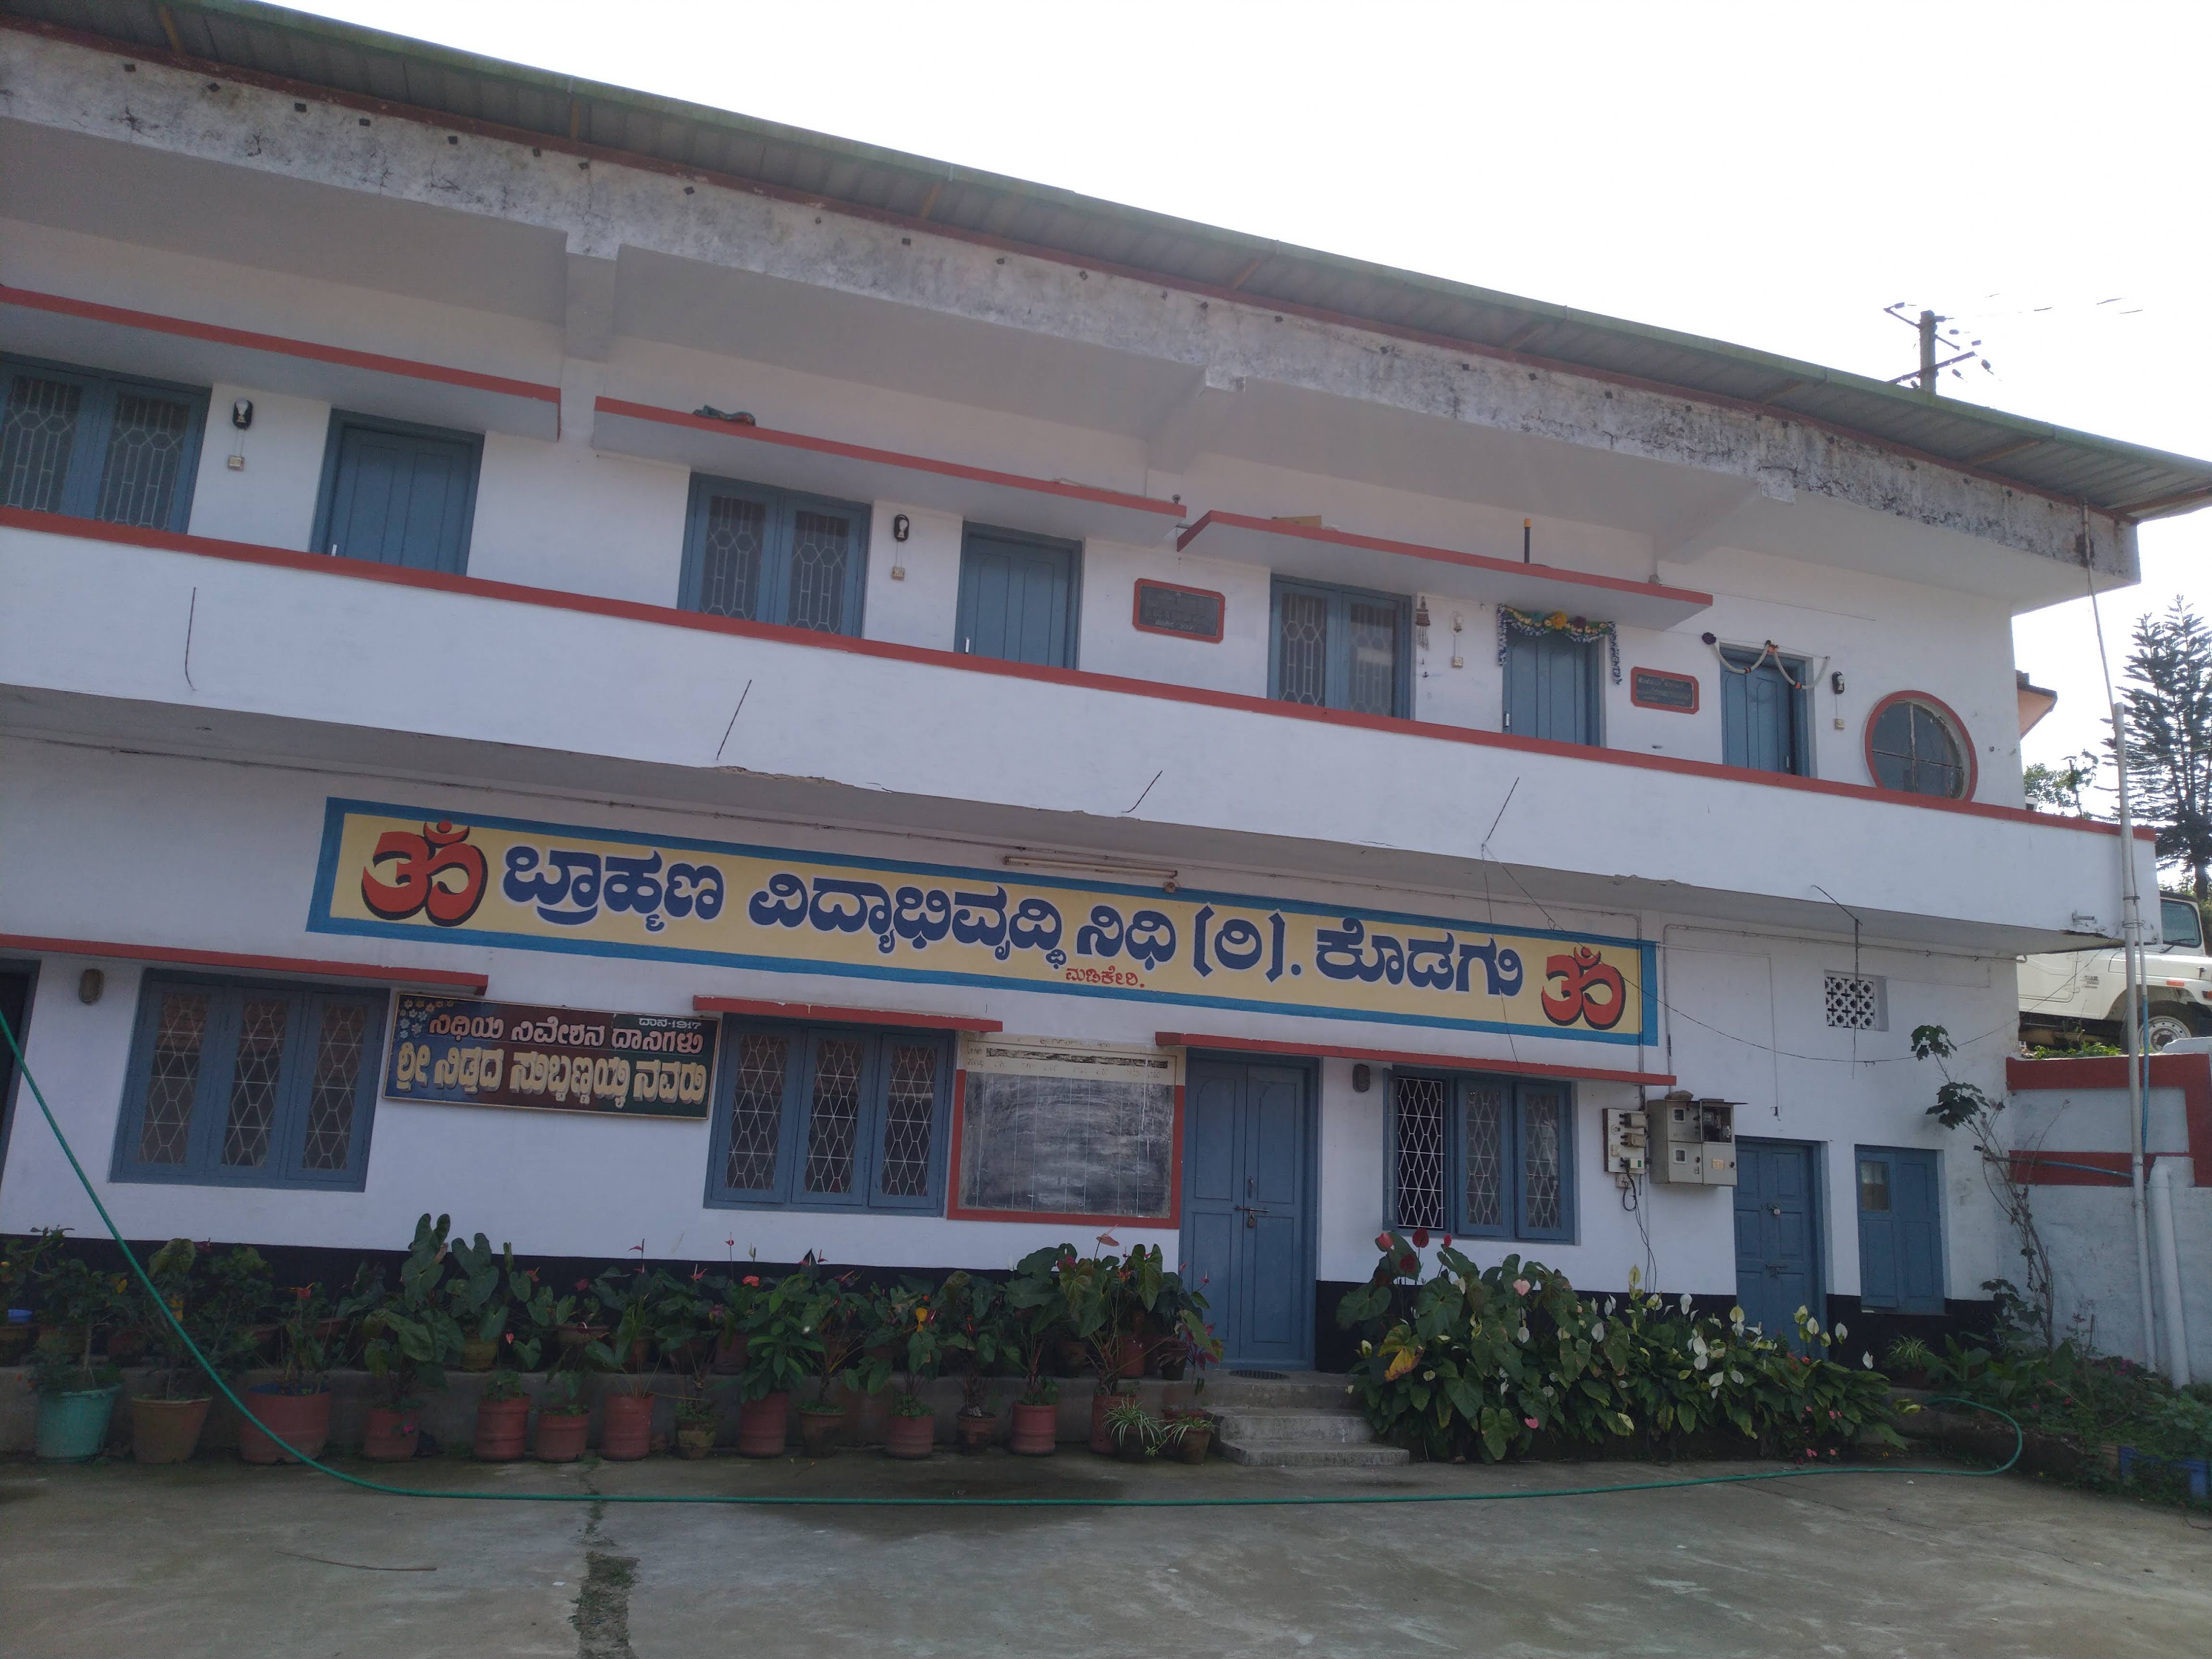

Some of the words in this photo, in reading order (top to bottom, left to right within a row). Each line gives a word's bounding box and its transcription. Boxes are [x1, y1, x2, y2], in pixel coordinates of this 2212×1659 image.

[502, 845, 724, 932] ಬ್ರಾಹ್ಮಣ
[1077, 905, 1176, 971] ನಿಧಿ
[1316, 918, 1523, 997] ಕೊಡಗು
[429, 1014, 505, 1041] ನಿಧಿಯ
[611, 1028, 704, 1054] ದಾನಿಗಳು
[396, 1041, 431, 1092] ಶ್ರೀ
